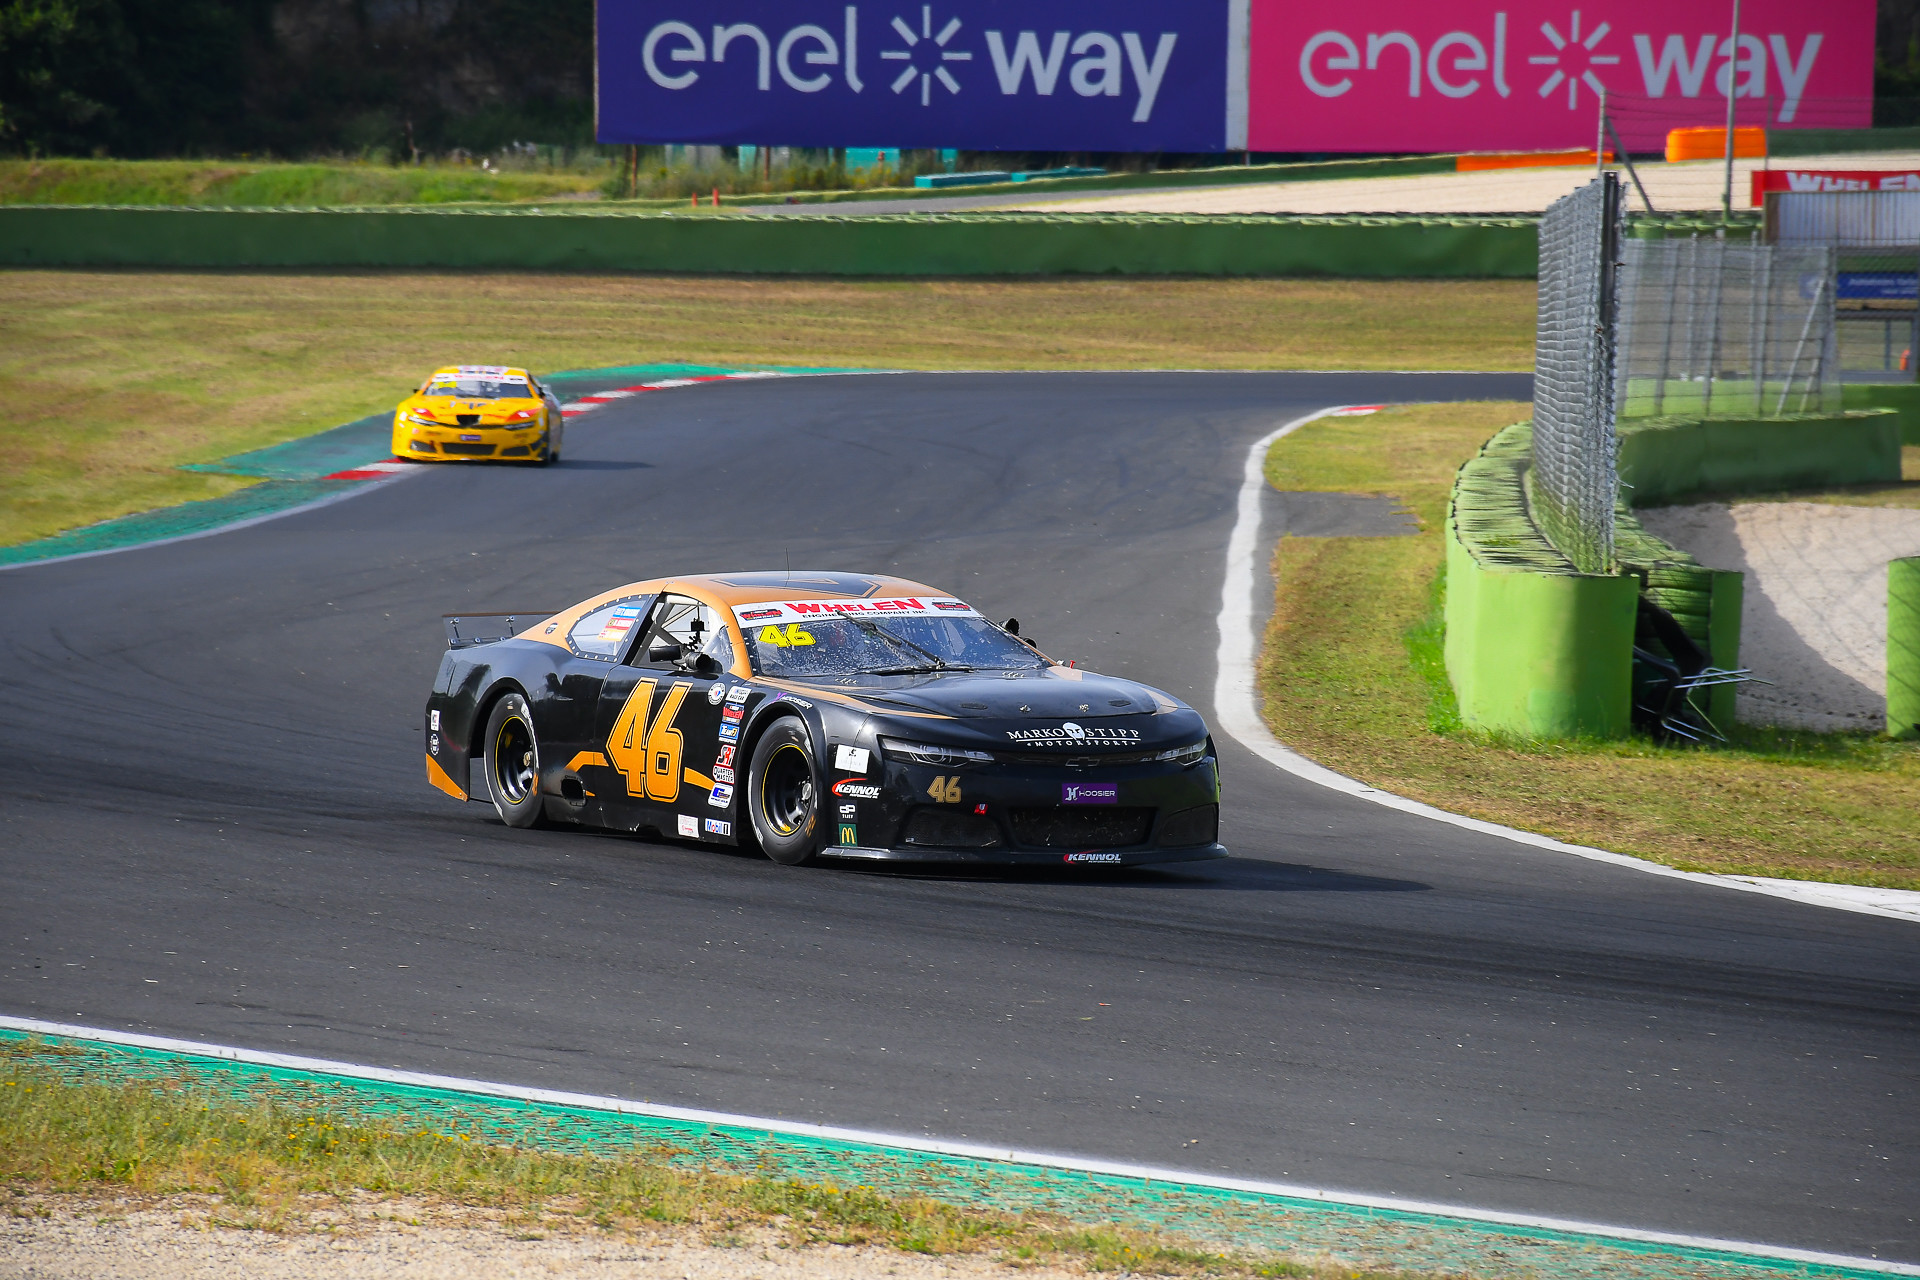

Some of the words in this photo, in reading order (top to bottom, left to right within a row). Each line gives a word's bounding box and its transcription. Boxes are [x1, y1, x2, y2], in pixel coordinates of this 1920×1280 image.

[642, 5, 865, 94] enel
[984, 31, 1178, 123] way
[1300, 12, 1511, 98] enel
[1632, 33, 1824, 122] way
[784, 597, 926, 614] WHELEN
[759, 623, 817, 648] 46
[606, 677, 694, 803] 46
[1006, 727, 1065, 740] MARKO
[1085, 727, 1139, 738] STIPP
[714, 766, 733, 776] QUARTER
[716, 774, 734, 782] MASTER
[834, 784, 880, 796] KENNOL
[927, 775, 962, 803] 46
[706, 820, 723, 833] Mobil
[1067, 853, 1122, 861] KENNOL
